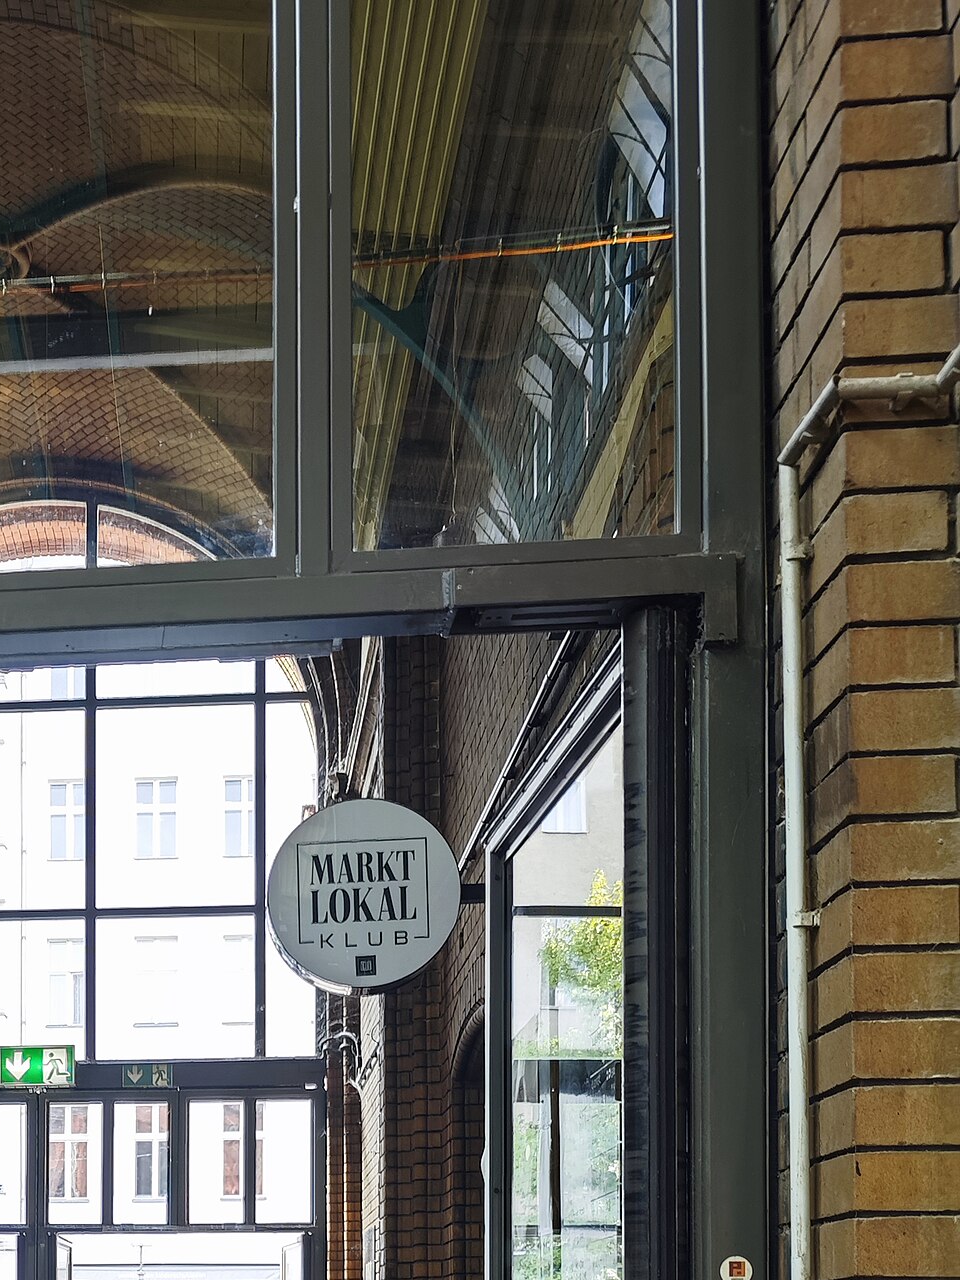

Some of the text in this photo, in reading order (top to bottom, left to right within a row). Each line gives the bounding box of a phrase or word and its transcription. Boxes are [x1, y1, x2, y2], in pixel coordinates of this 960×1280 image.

[310, 850, 415, 885] MARKT
[311, 886, 417, 924] LOKAL
[320, 930, 409, 949] KLUB
